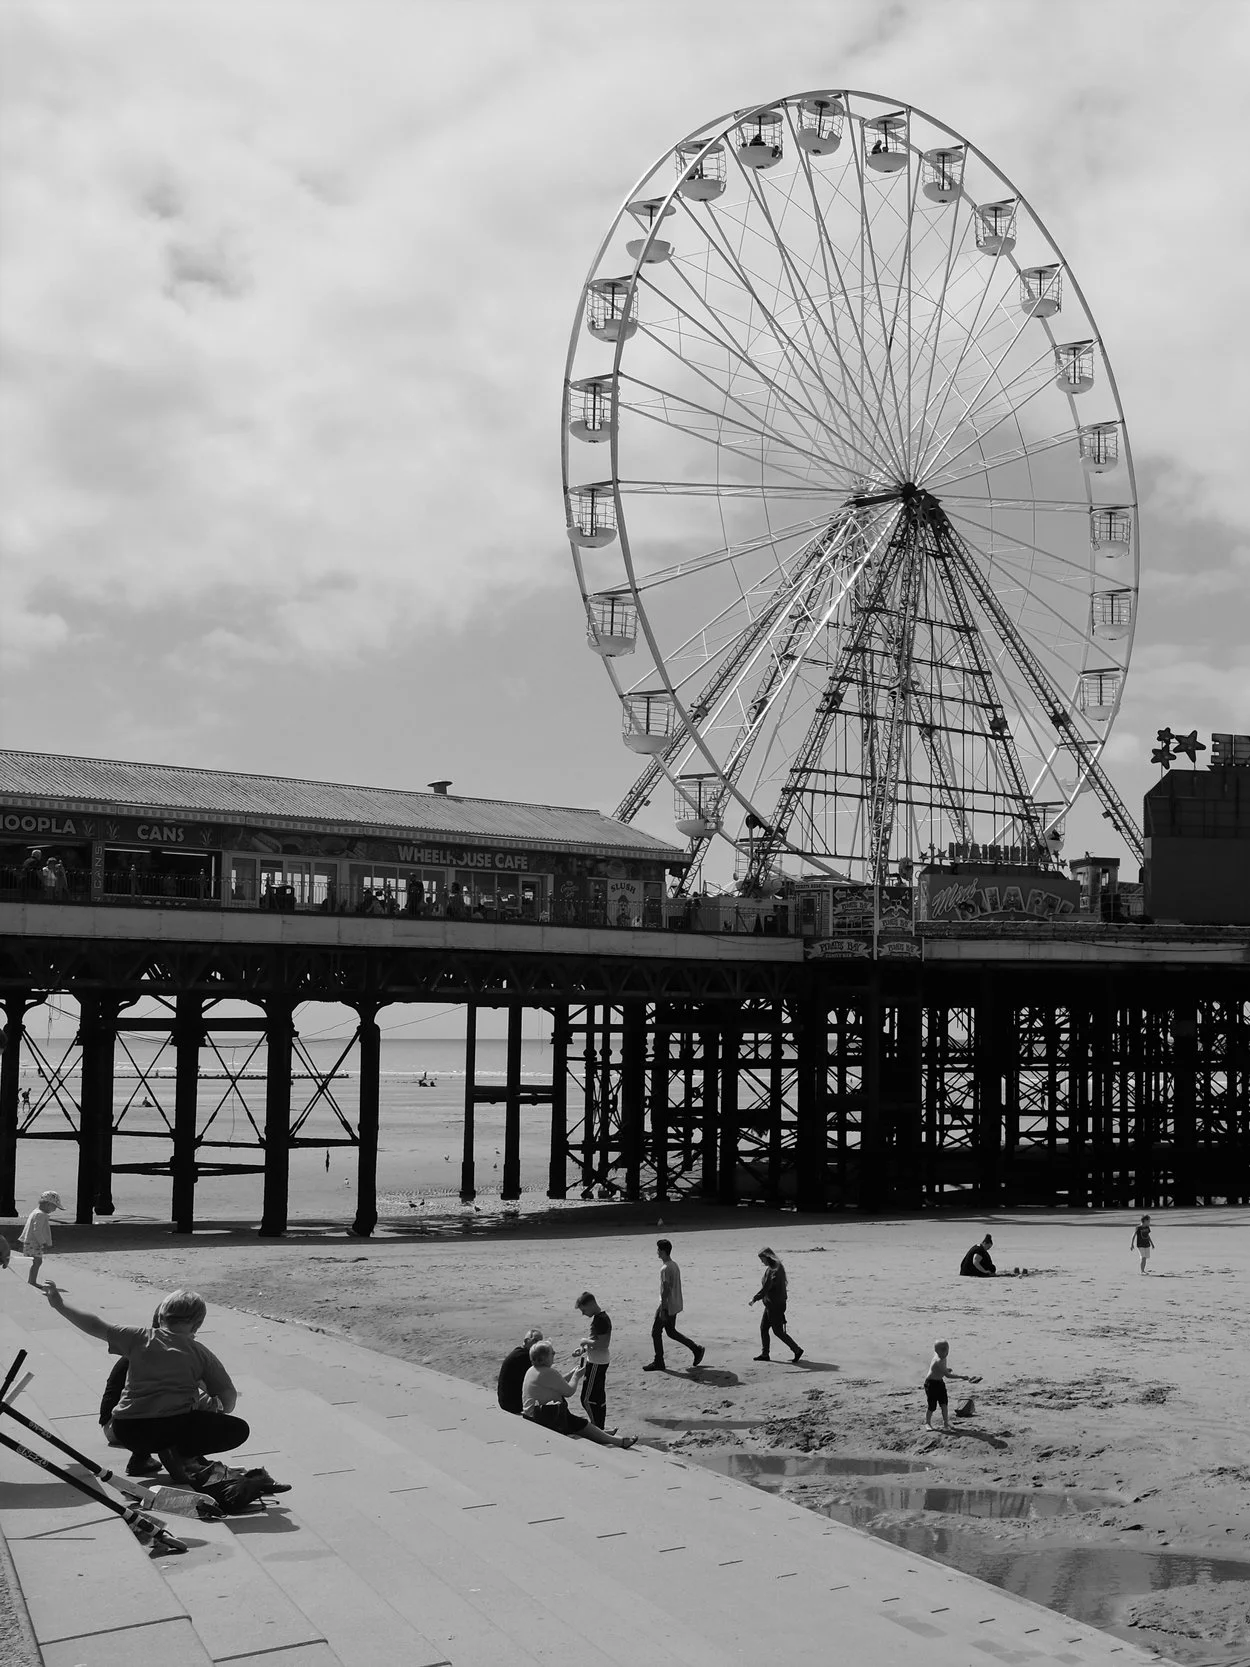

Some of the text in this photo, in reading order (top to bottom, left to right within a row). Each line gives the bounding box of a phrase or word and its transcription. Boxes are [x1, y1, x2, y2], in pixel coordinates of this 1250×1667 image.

[0, 814, 76, 834] OOPLA
[137, 824, 185, 842] CANS
[610, 882, 637, 894] SLUSH
